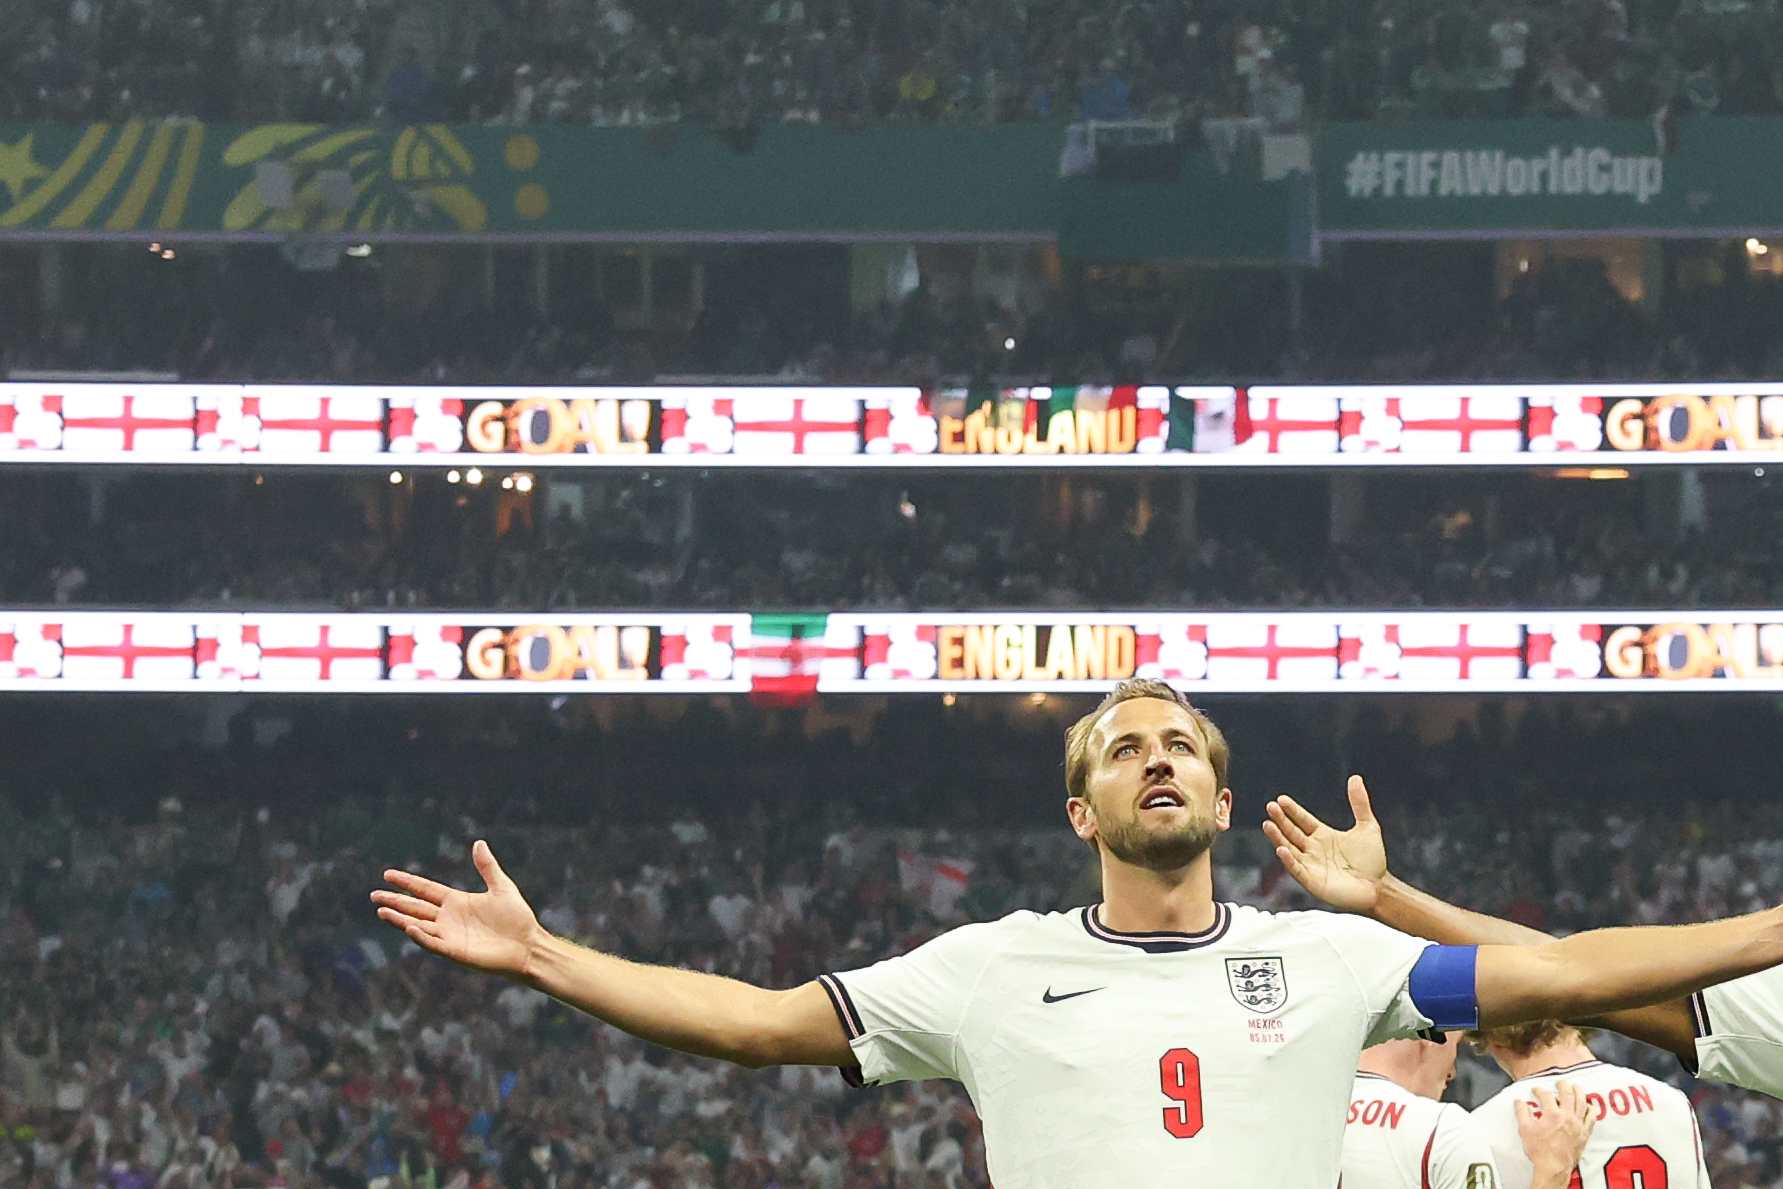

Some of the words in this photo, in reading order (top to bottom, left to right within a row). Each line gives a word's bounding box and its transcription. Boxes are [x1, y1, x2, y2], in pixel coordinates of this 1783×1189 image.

[1346, 148, 1663, 203] #FIFAWorldCup
[467, 398, 651, 455] GOAL!
[466, 624, 651, 681] GOAL!
[938, 624, 1137, 681] ENGLAND
[1248, 1018, 1283, 1030] MEXICO
[1158, 1047, 1204, 1139] 9
